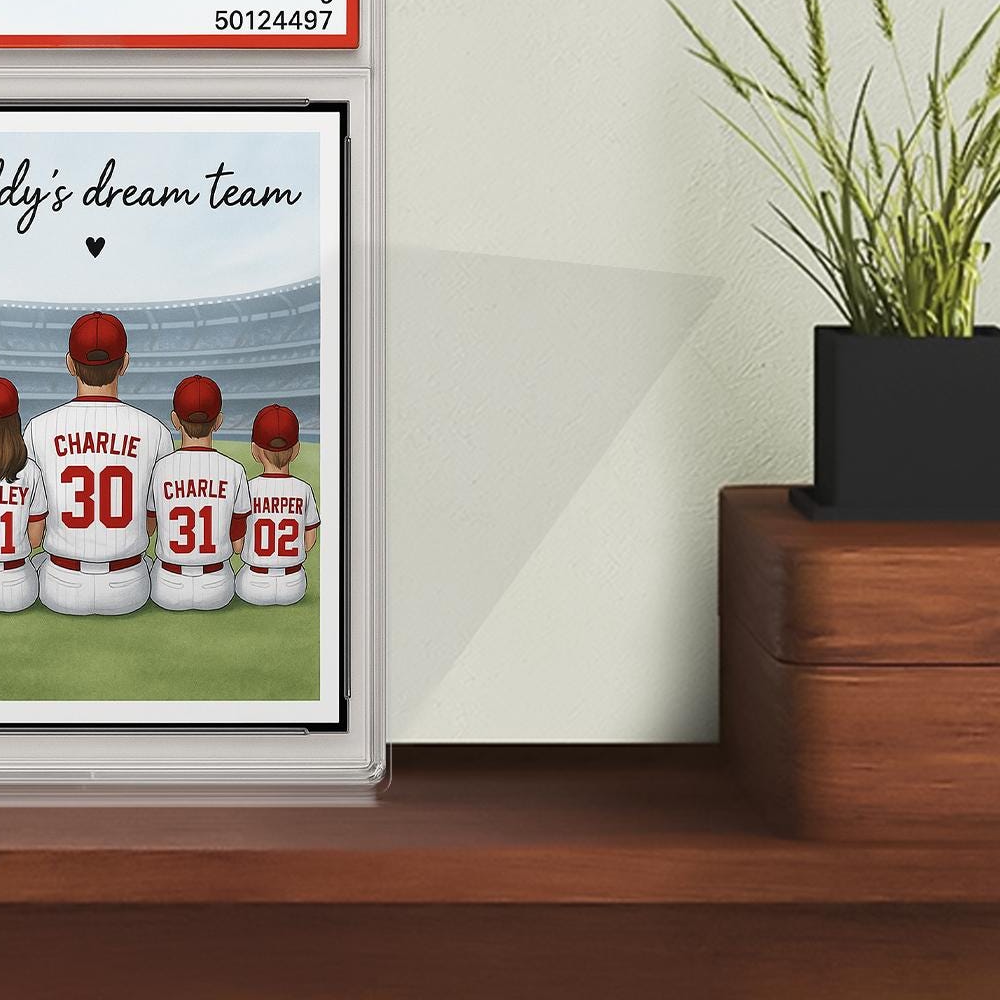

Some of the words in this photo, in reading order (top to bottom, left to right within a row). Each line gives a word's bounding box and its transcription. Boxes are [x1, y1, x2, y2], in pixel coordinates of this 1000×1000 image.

[214, 10, 333, 31] 50124497
[82, 157, 201, 210] dream
[204, 161, 303, 210] team
[54, 431, 141, 459] CHARLIE
[60, 465, 133, 529] 30
[163, 479, 229, 500] CHARLE
[253, 497, 304, 515] HARPER
[168, 505, 217, 554] 31
[254, 518, 299, 557] 02
